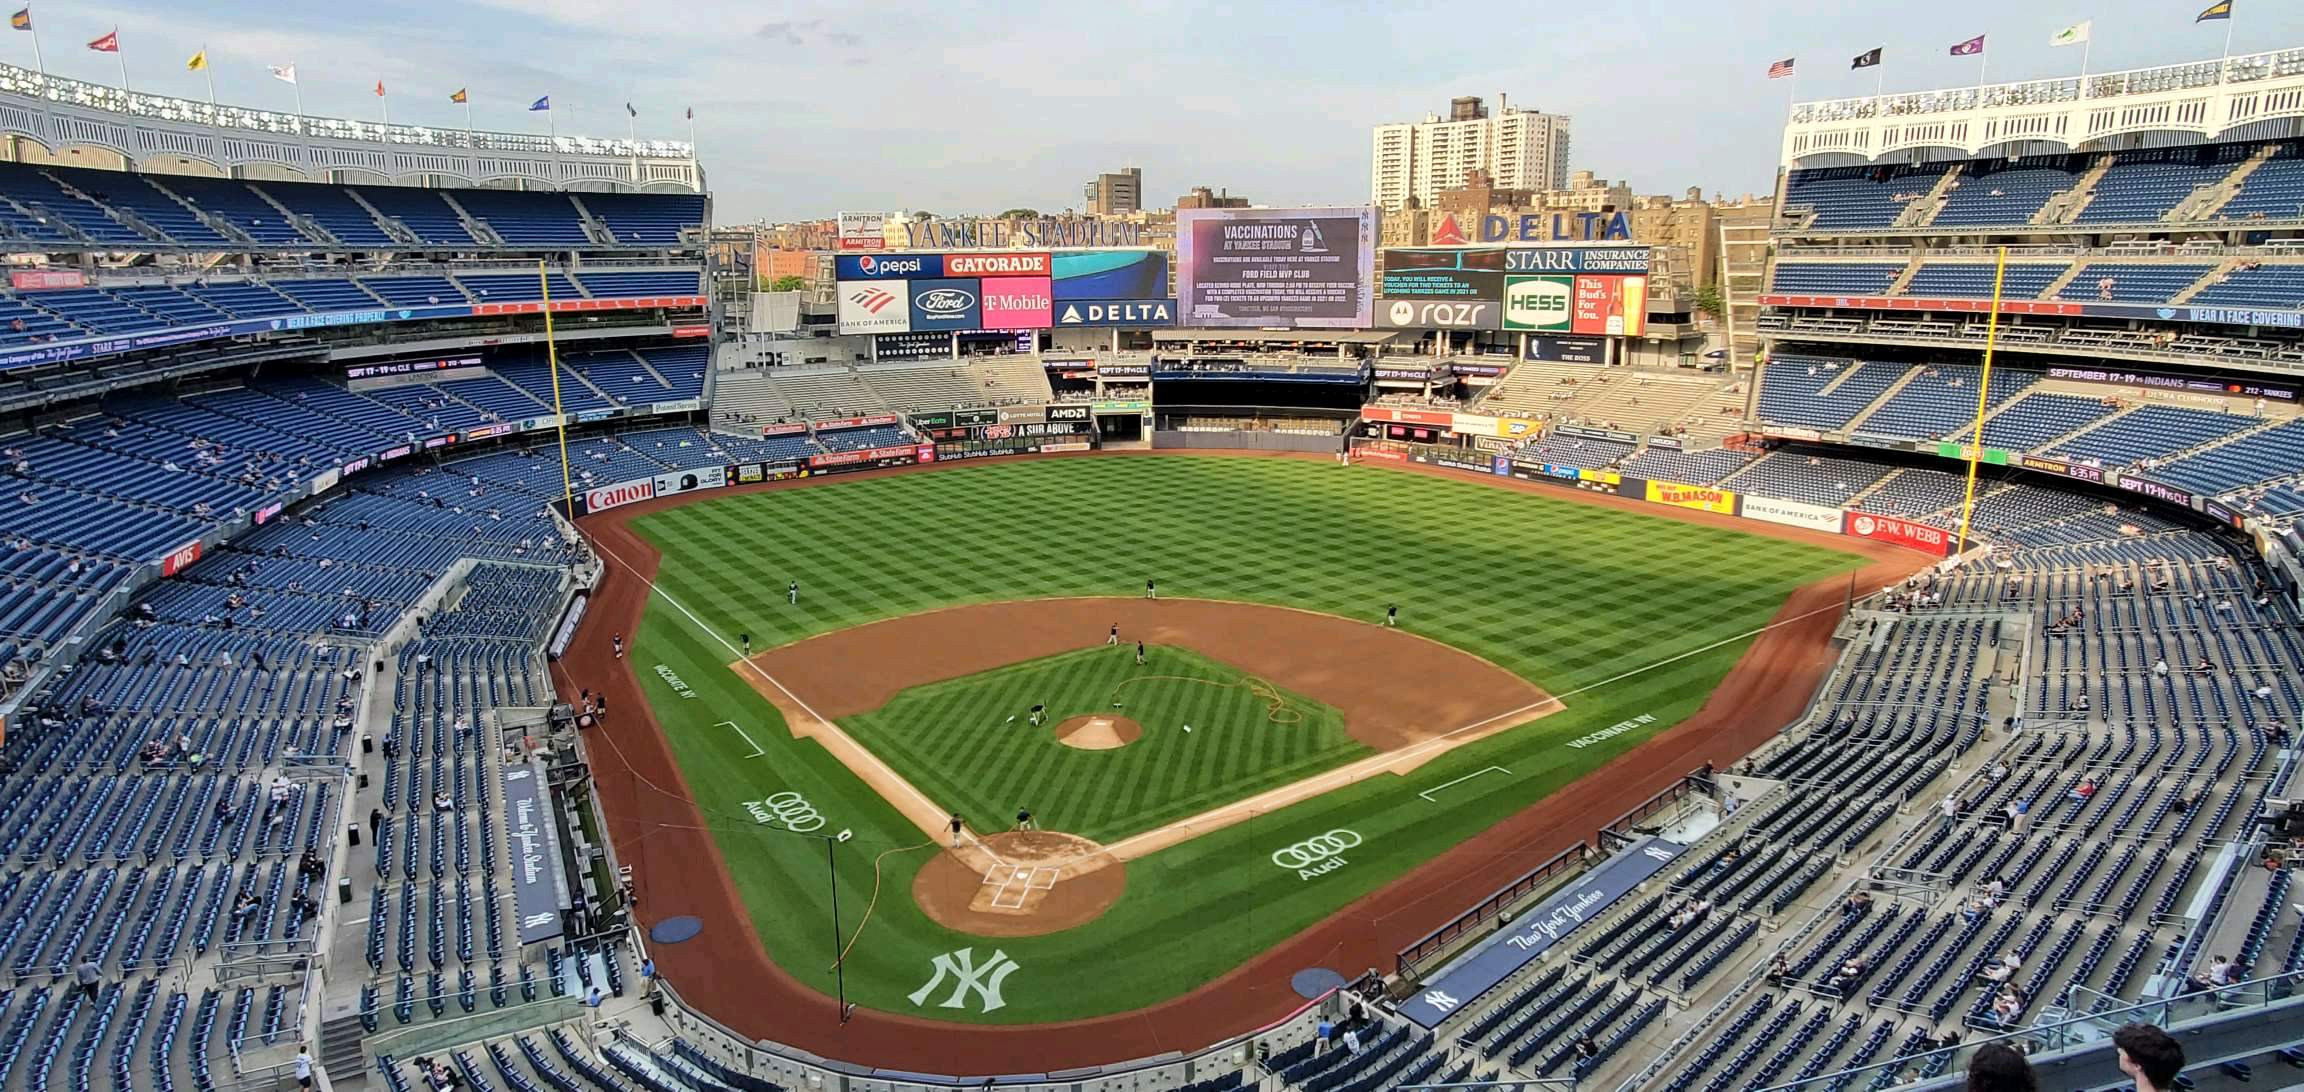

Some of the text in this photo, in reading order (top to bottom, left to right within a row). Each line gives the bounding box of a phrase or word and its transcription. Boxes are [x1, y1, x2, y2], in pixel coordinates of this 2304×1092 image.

[842, 214, 882, 222] ARMITRON
[901, 221, 1141, 248] YANKEE STADIUM
[1224, 225, 1298, 239] VACCINATIONS
[1484, 212, 1633, 241] DELTA
[1505, 250, 1577, 270] STARR
[1584, 249, 1649, 260] INSURANCE
[880, 258, 920, 274] pepsi
[951, 257, 1043, 272] GATORADE
[1583, 260, 1649, 270] COMPANIES
[1242, 271, 1310, 279] FORD FIELD MVP CLUB
[1578, 279, 1603, 289] This
[926, 292, 964, 309] Ford
[1578, 289, 1607, 299] Bud's
[1510, 295, 1566, 311] HESS
[1578, 300, 1596, 309] For
[1088, 304, 1169, 321] DELTA
[1421, 303, 1486, 325] razr
[1577, 310, 1600, 319] You.
[2190, 308, 2301, 327] WEAR A FACE COVERING
[2050, 367, 2107, 381] SEPTEMBER
[2109, 372, 2136, 383] 17-19
[2144, 377, 2184, 388] INDIANS
[1051, 409, 1077, 419] AMD
[1047, 422, 1075, 434] ABOVE
[989, 448, 1015, 456] StubHub
[2023, 459, 2066, 473] ARMITRON
[2070, 467, 2088, 478] 6:35
[588, 482, 653, 509] Canon
[1682, 490, 1723, 503] MASON
[2119, 477, 2143, 493] SEPT
[2144, 483, 2166, 499] 17-19
[2174, 492, 2189, 506] CLE
[1745, 503, 1767, 512] BANK
[1780, 509, 1819, 521] AMERICA
[1877, 520, 1941, 545] F.W. WEBB
[173, 547, 195, 571] AVIS
[1566, 713, 1657, 748] VACCINATE NY
[741, 800, 777, 823] Audi
[1298, 856, 1348, 881] Audi
[1506, 889, 1605, 950] New York Yankees
[907, 946, 1021, 1014] NY
